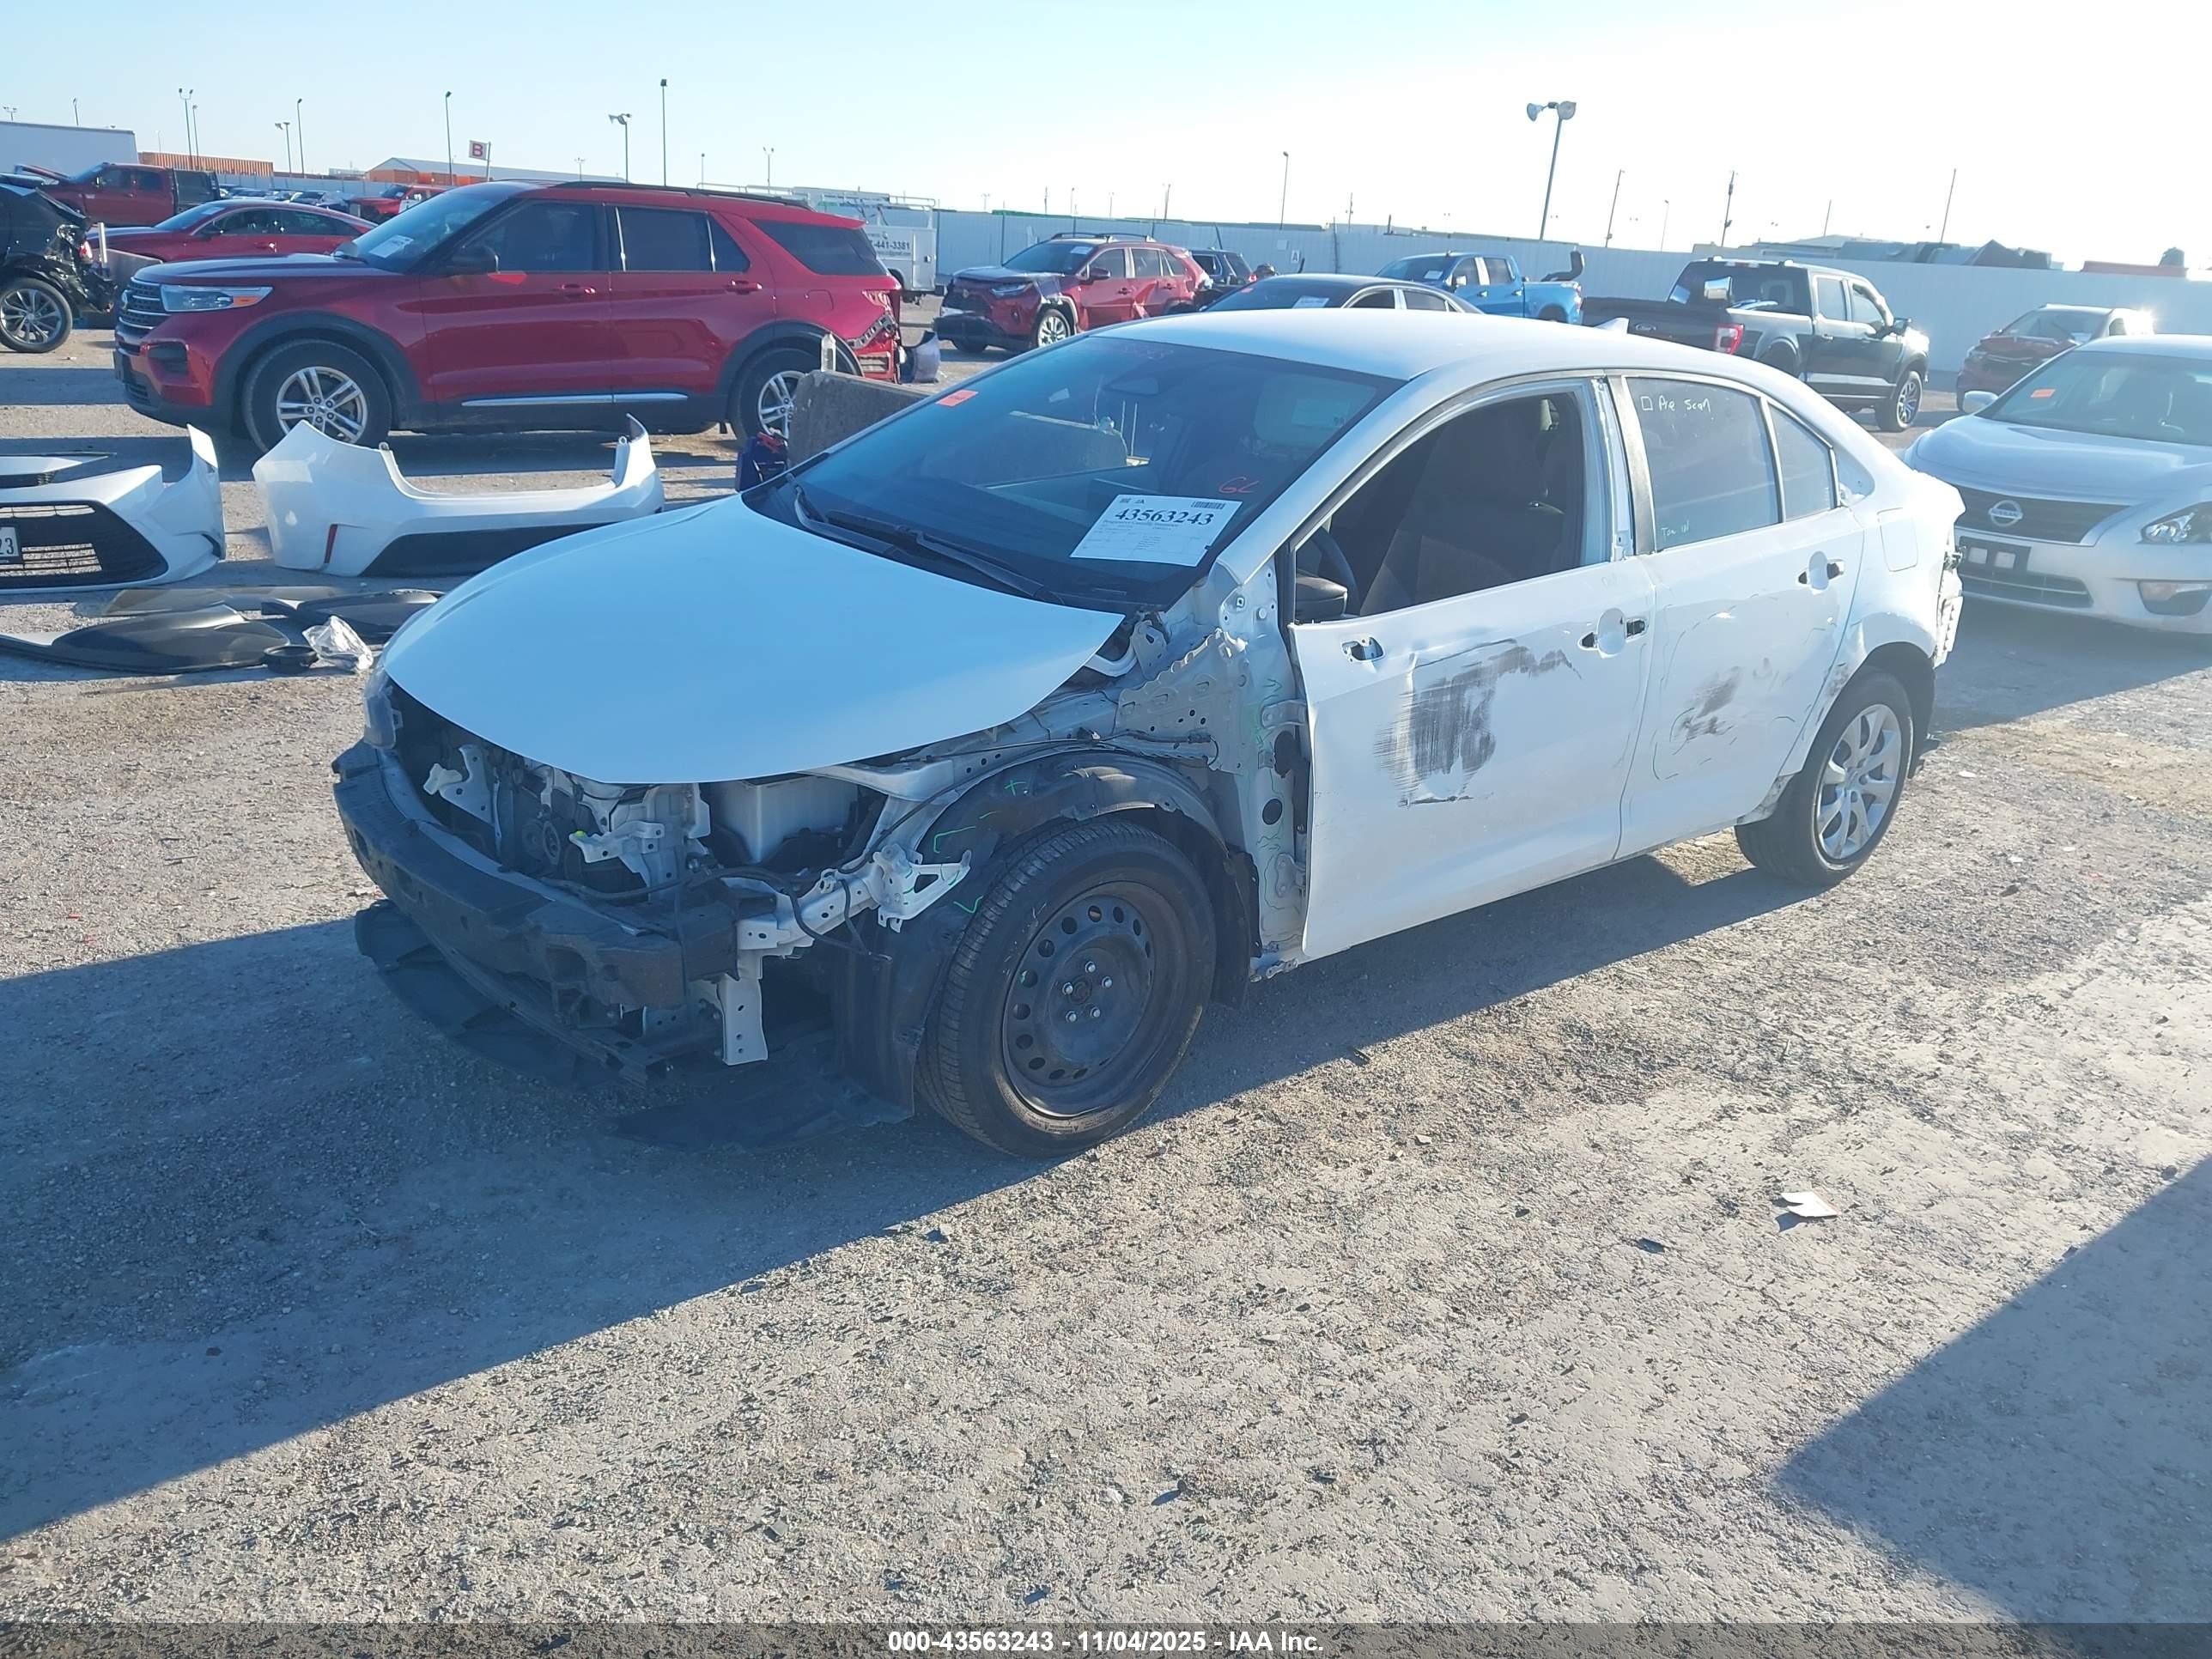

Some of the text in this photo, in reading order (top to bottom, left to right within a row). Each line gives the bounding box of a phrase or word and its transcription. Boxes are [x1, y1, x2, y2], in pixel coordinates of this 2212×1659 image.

[472, 143, 483, 157] B
[1291, 252, 1298, 262] A
[1115, 508, 1214, 526] 43563243
